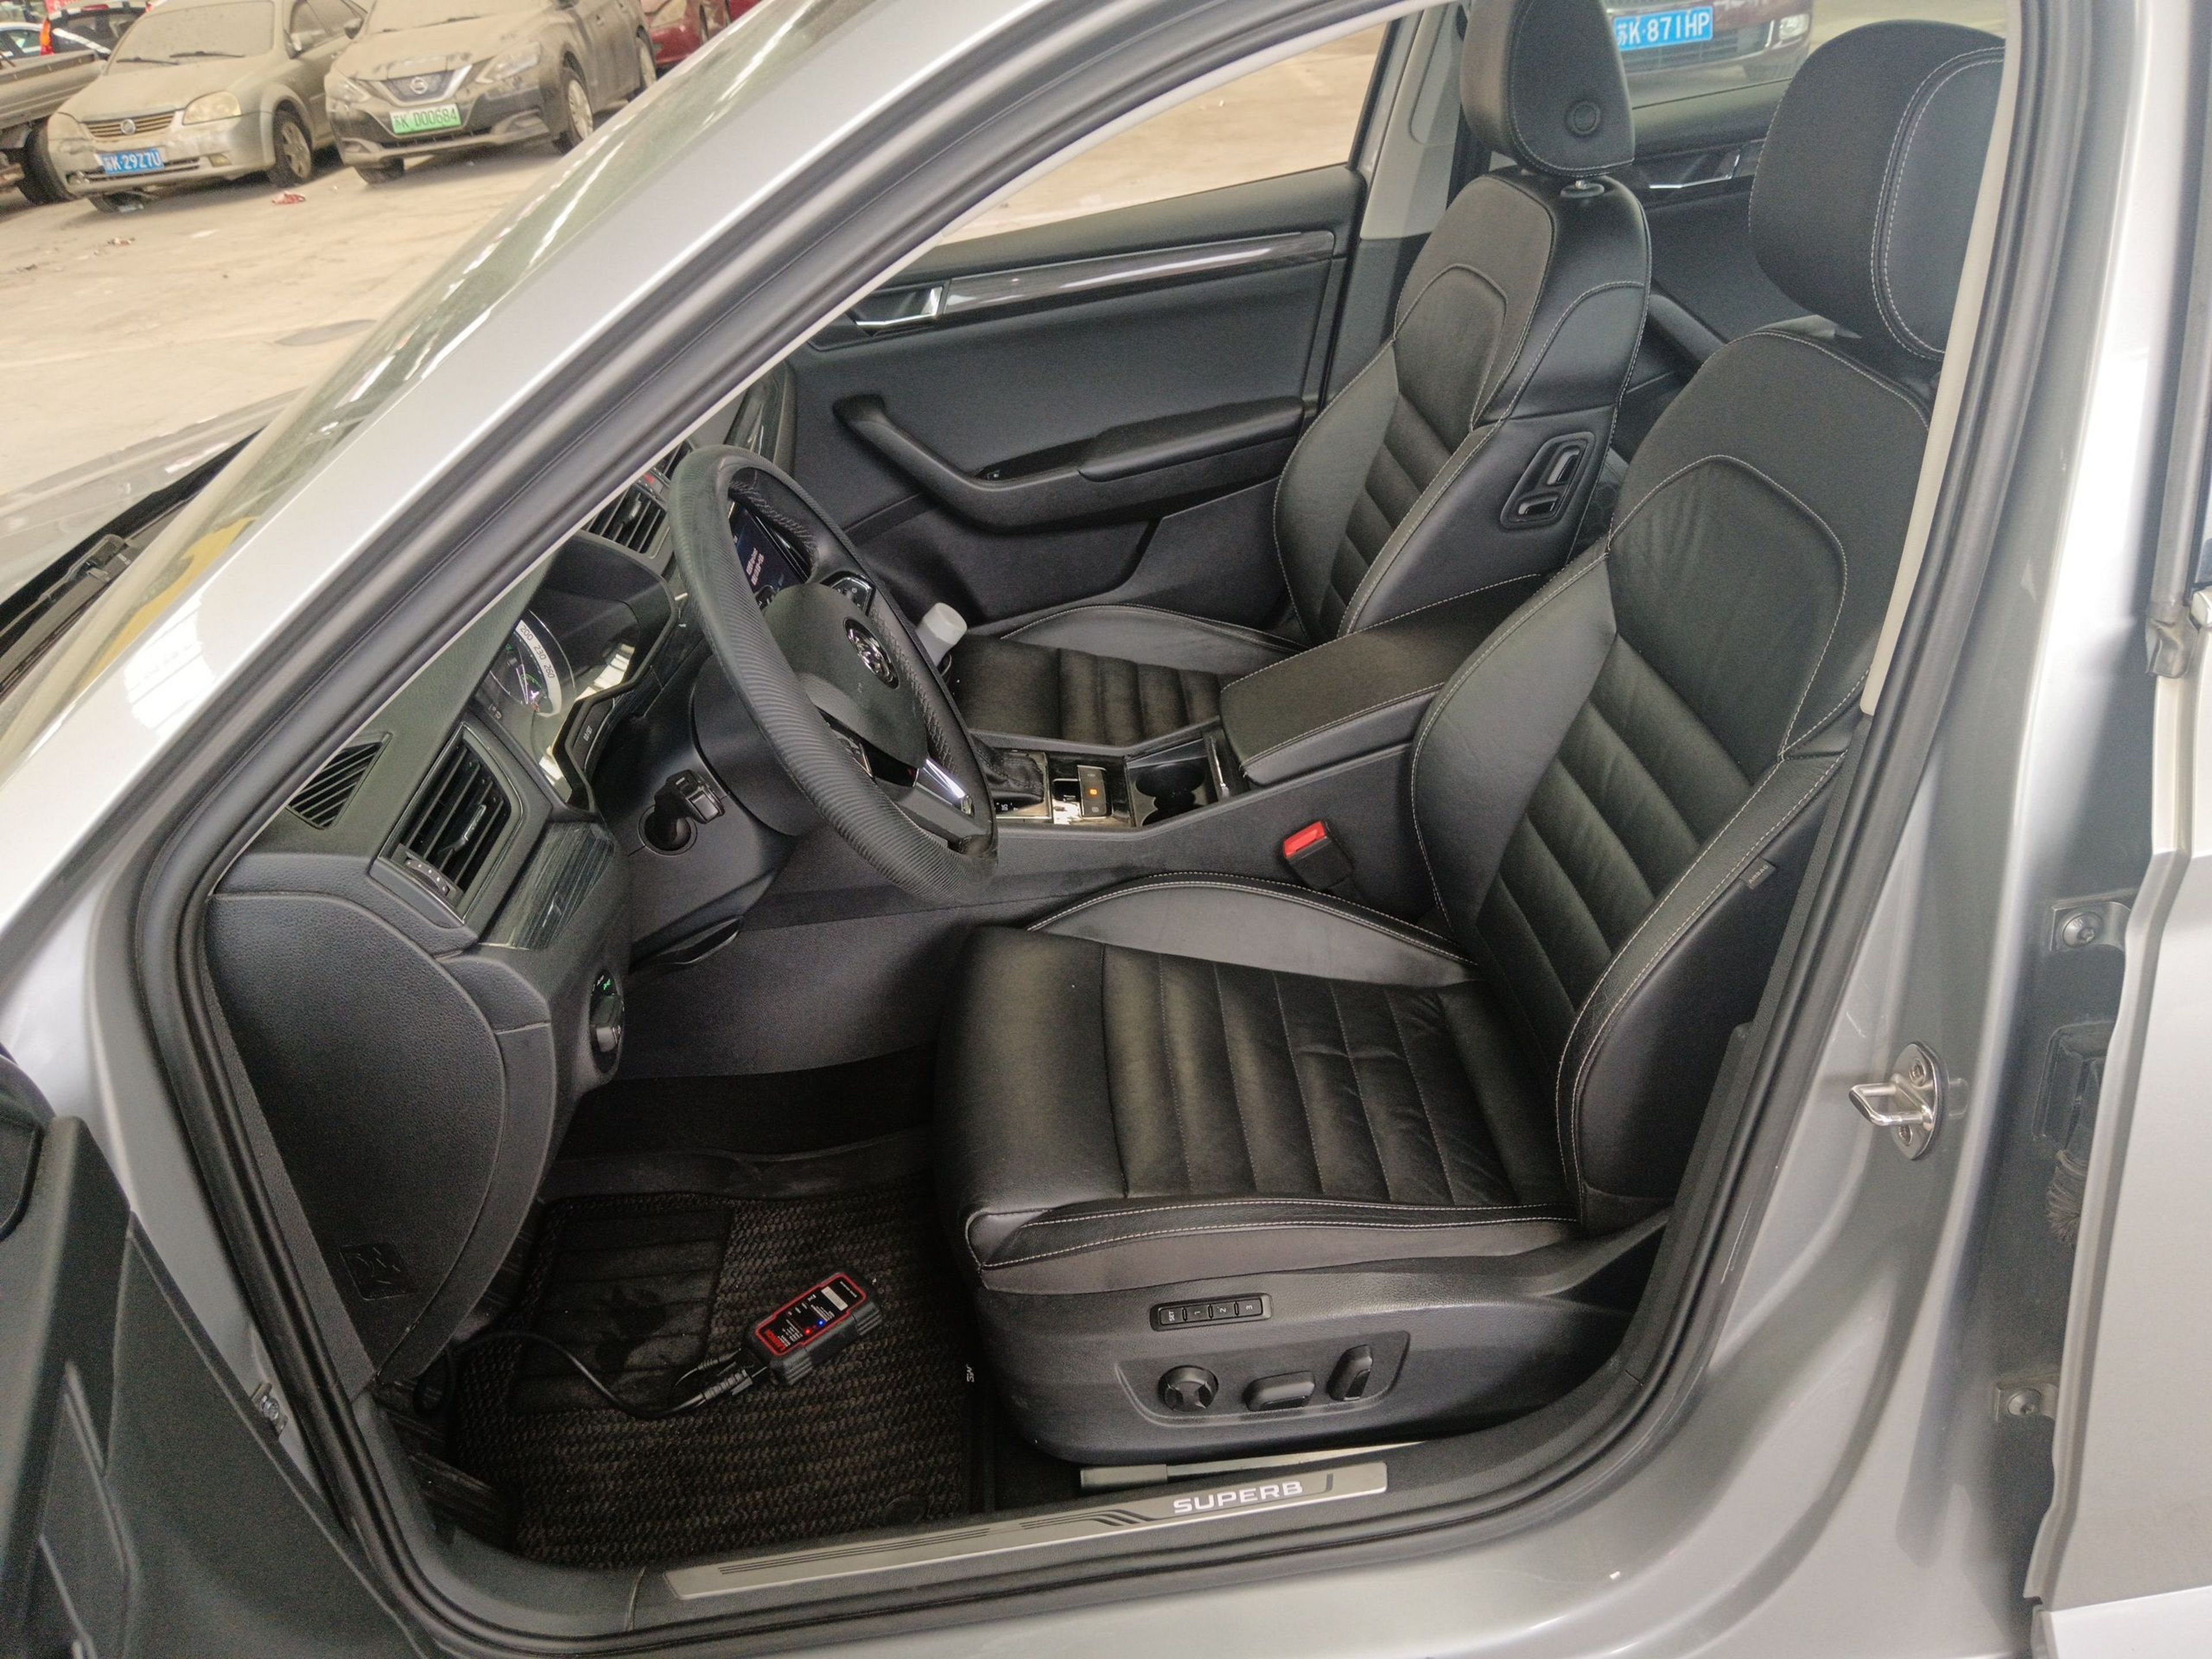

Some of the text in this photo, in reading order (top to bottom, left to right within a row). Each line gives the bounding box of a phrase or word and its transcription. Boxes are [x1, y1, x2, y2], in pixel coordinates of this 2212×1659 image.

[520, 626, 533, 641] 200
[533, 645, 547, 660] 230
[544, 664, 555, 679] 260
[1749, 865, 1768, 884] AIRBAG
[1173, 1480, 1303, 1514] SUPERB
